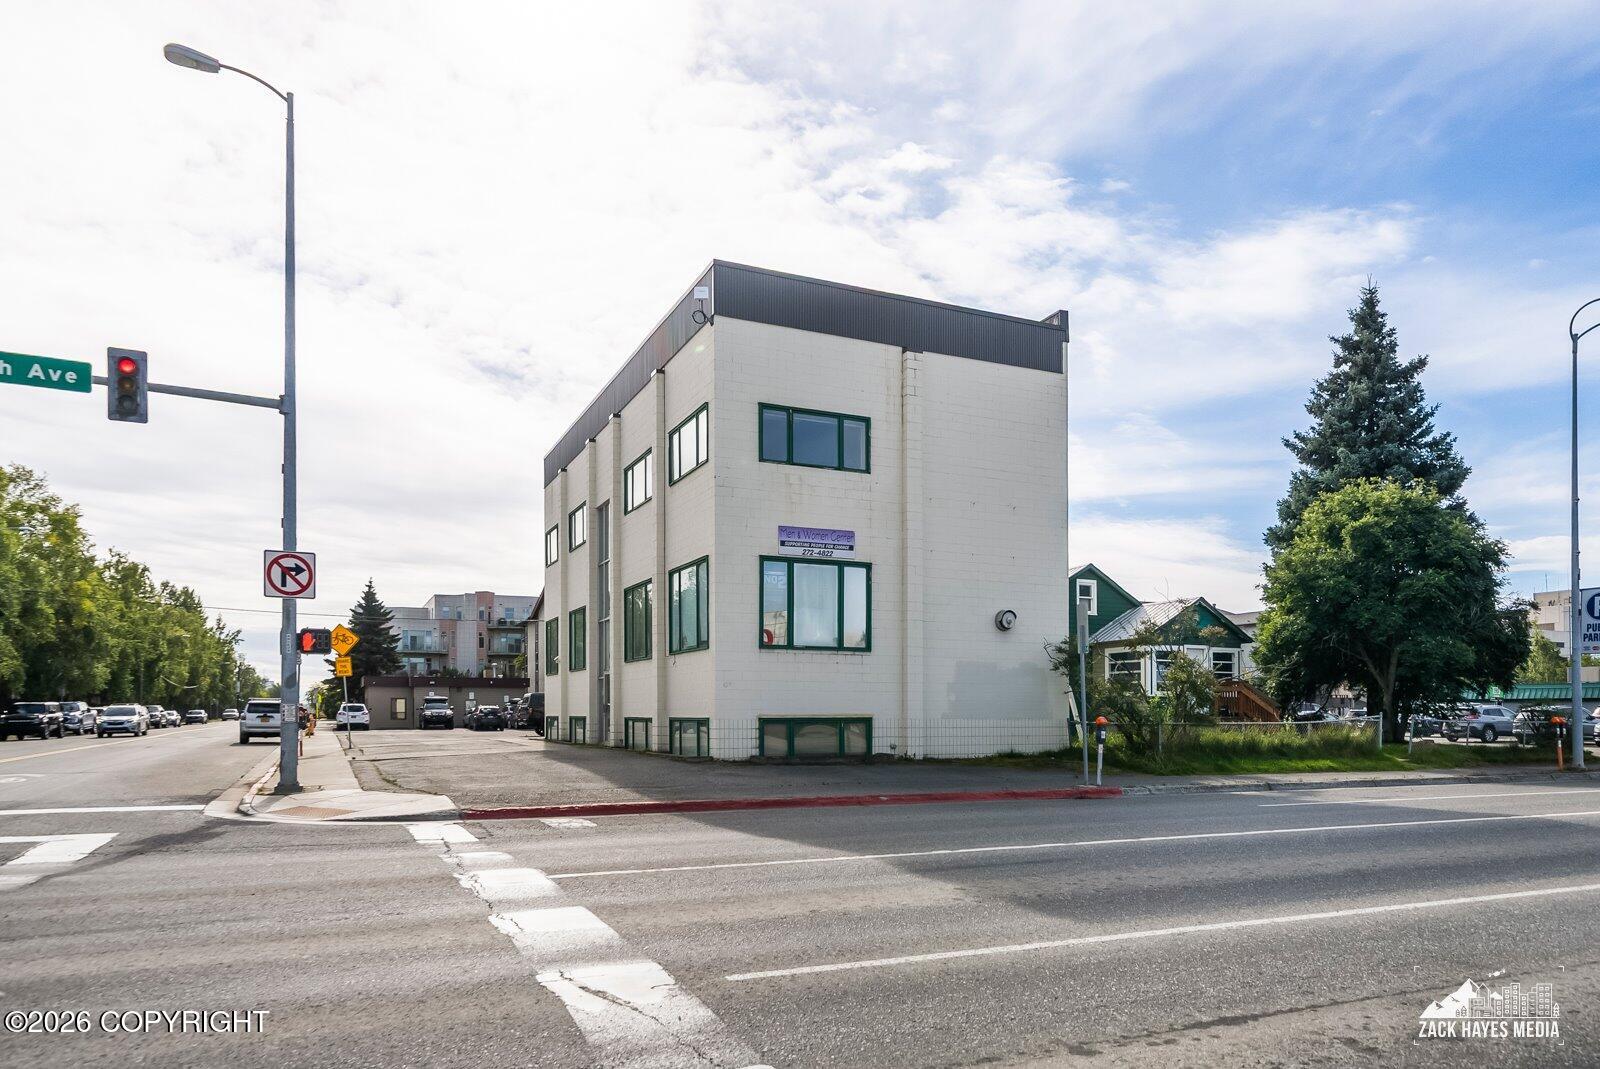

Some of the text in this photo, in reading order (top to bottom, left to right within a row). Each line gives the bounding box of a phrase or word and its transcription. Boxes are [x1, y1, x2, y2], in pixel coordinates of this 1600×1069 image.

[27, 363, 78, 384] Ave
[802, 528, 829, 540] Women
[831, 531, 855, 542] Center
[802, 549, 834, 557] 272-4822
